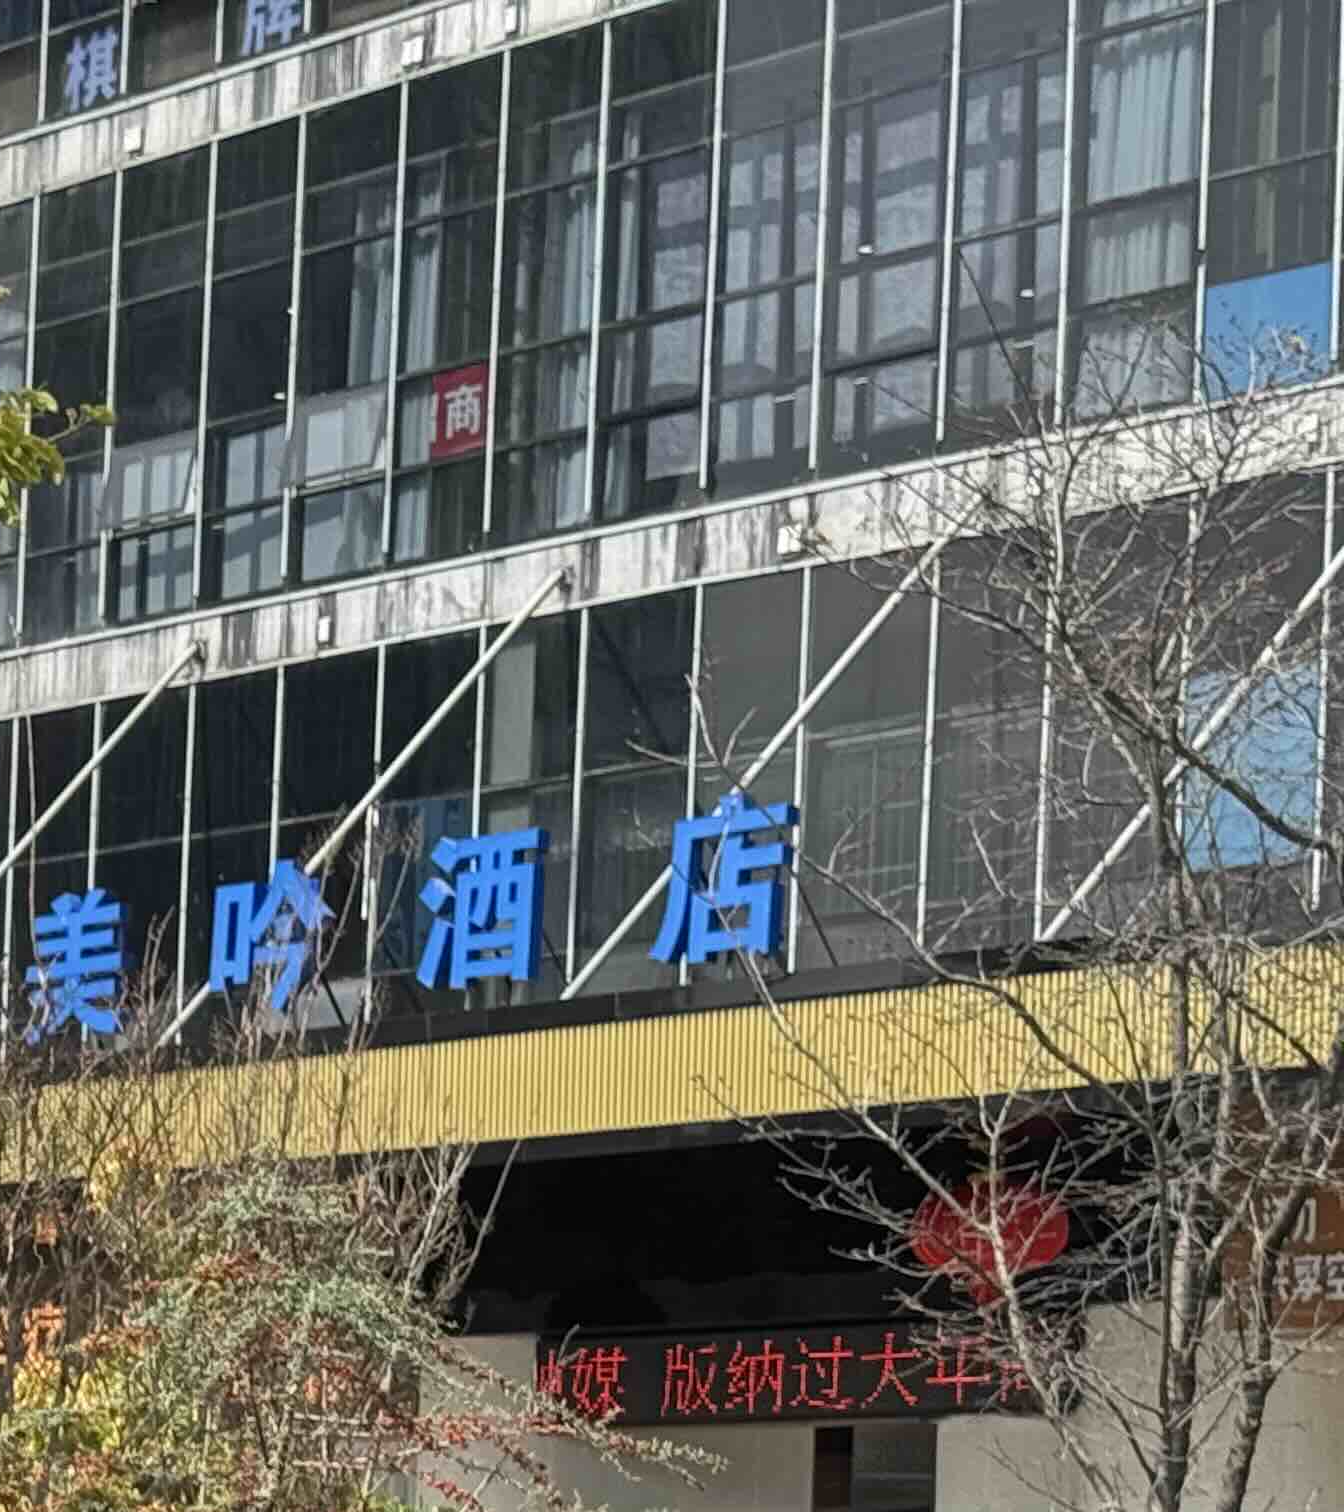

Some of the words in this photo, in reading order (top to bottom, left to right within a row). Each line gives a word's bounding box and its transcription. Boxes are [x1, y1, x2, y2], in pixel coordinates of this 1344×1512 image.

[64, 0, 302, 112] 棋牌
[25, 792, 800, 1044] 美吟酒店
